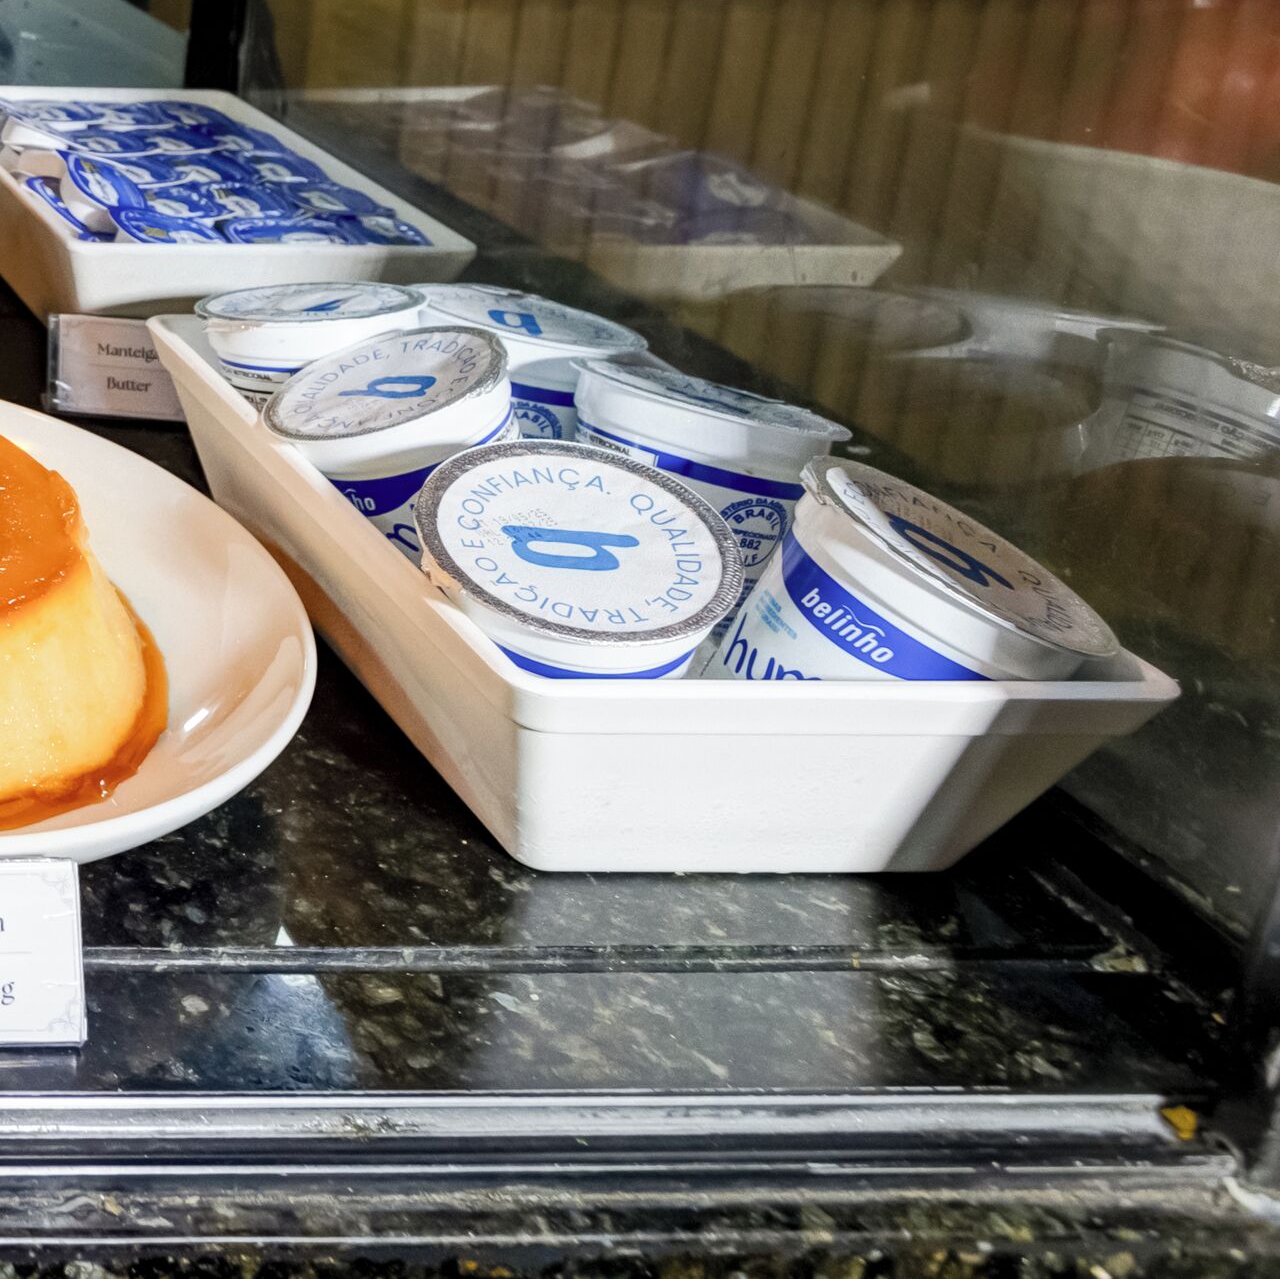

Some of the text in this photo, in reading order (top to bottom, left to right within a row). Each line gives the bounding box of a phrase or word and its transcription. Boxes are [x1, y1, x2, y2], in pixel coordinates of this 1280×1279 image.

[106, 376, 152, 393] Butter
[733, 508, 780, 531] BRASIL
[460, 537, 485, 550] E
[474, 556, 650, 625] TRADIÇÃO
[801, 587, 895, 664] belinho
